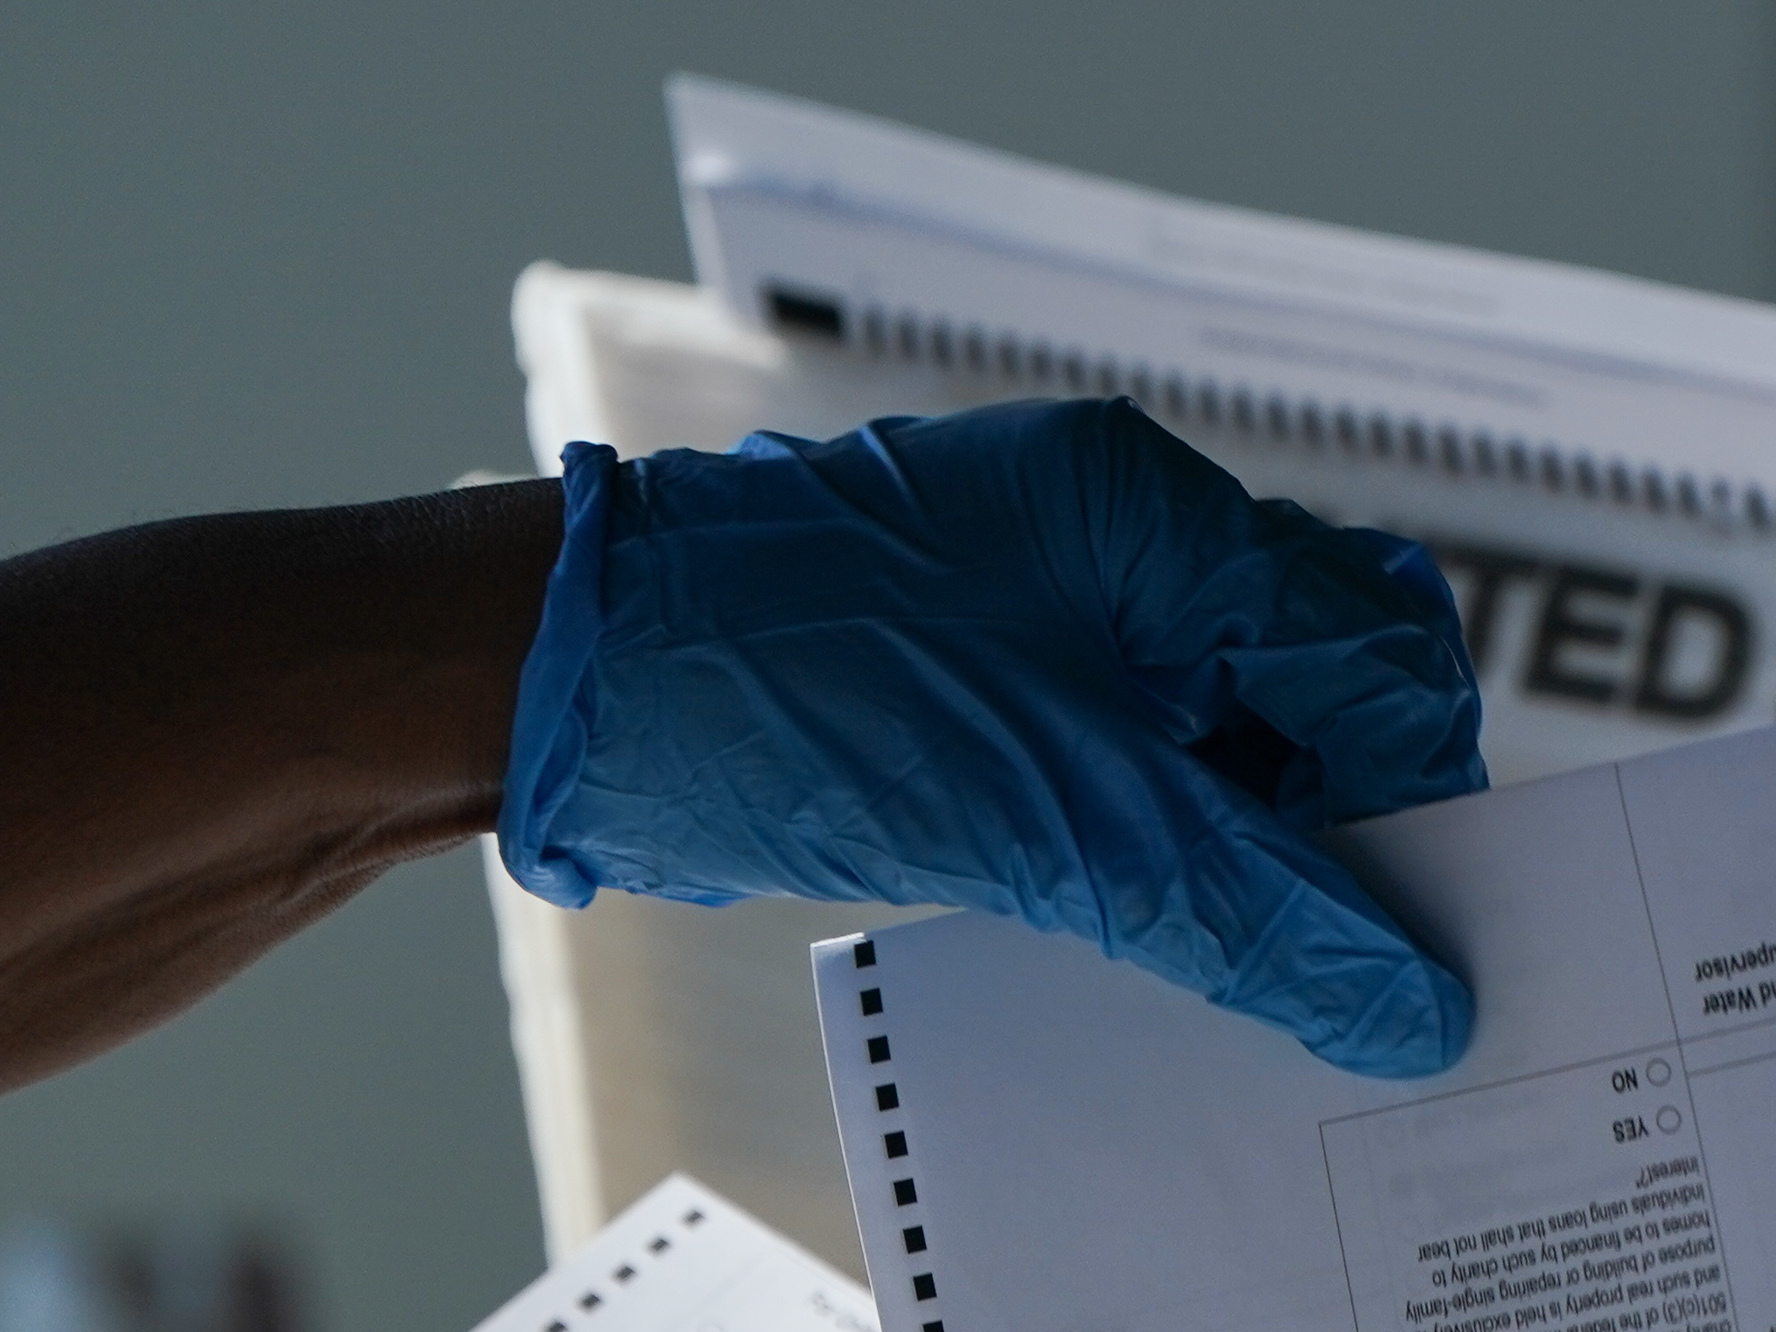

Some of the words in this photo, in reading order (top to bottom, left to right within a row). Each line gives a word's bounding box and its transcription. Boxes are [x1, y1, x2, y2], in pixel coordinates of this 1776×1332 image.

[1703, 986, 1758, 1015] Water
[1611, 1068, 1639, 1094] NO
[1612, 1116, 1649, 1144] YES
[1588, 1199, 1629, 1224] using
[1630, 1183, 1706, 1216] individuals
[1517, 1218, 1547, 1243] that
[1547, 1209, 1589, 1233] loans
[1644, 1222, 1661, 1240] to
[1661, 1210, 1712, 1236] homes
[1452, 1234, 1478, 1258] not
[1480, 1225, 1515, 1252] shall
[1560, 1230, 1622, 1263] financed
[1623, 1224, 1644, 1245] be
[1417, 1239, 1452, 1263] bear
[1501, 1248, 1537, 1275] such
[1540, 1241, 1559, 1264] by
[1641, 1250, 1656, 1273] of
[1657, 1233, 1716, 1265] purpose
[1431, 1269, 1448, 1289] to
[1450, 1257, 1499, 1285] charity
[1565, 1267, 1581, 1287] or
[1582, 1254, 1640, 1282] building
[1693, 1264, 1721, 1290] and
[1498, 1271, 1562, 1301] repairing
[1626, 1280, 1655, 1305] real
[1656, 1271, 1691, 1297] such
[1405, 1286, 1496, 1325] single-family
[1548, 1301, 1563, 1321] is
[1565, 1282, 1624, 1316] property
[1514, 1304, 1548, 1330] held
[1618, 1311, 1643, 1332] the
[1645, 1306, 1660, 1330] of
